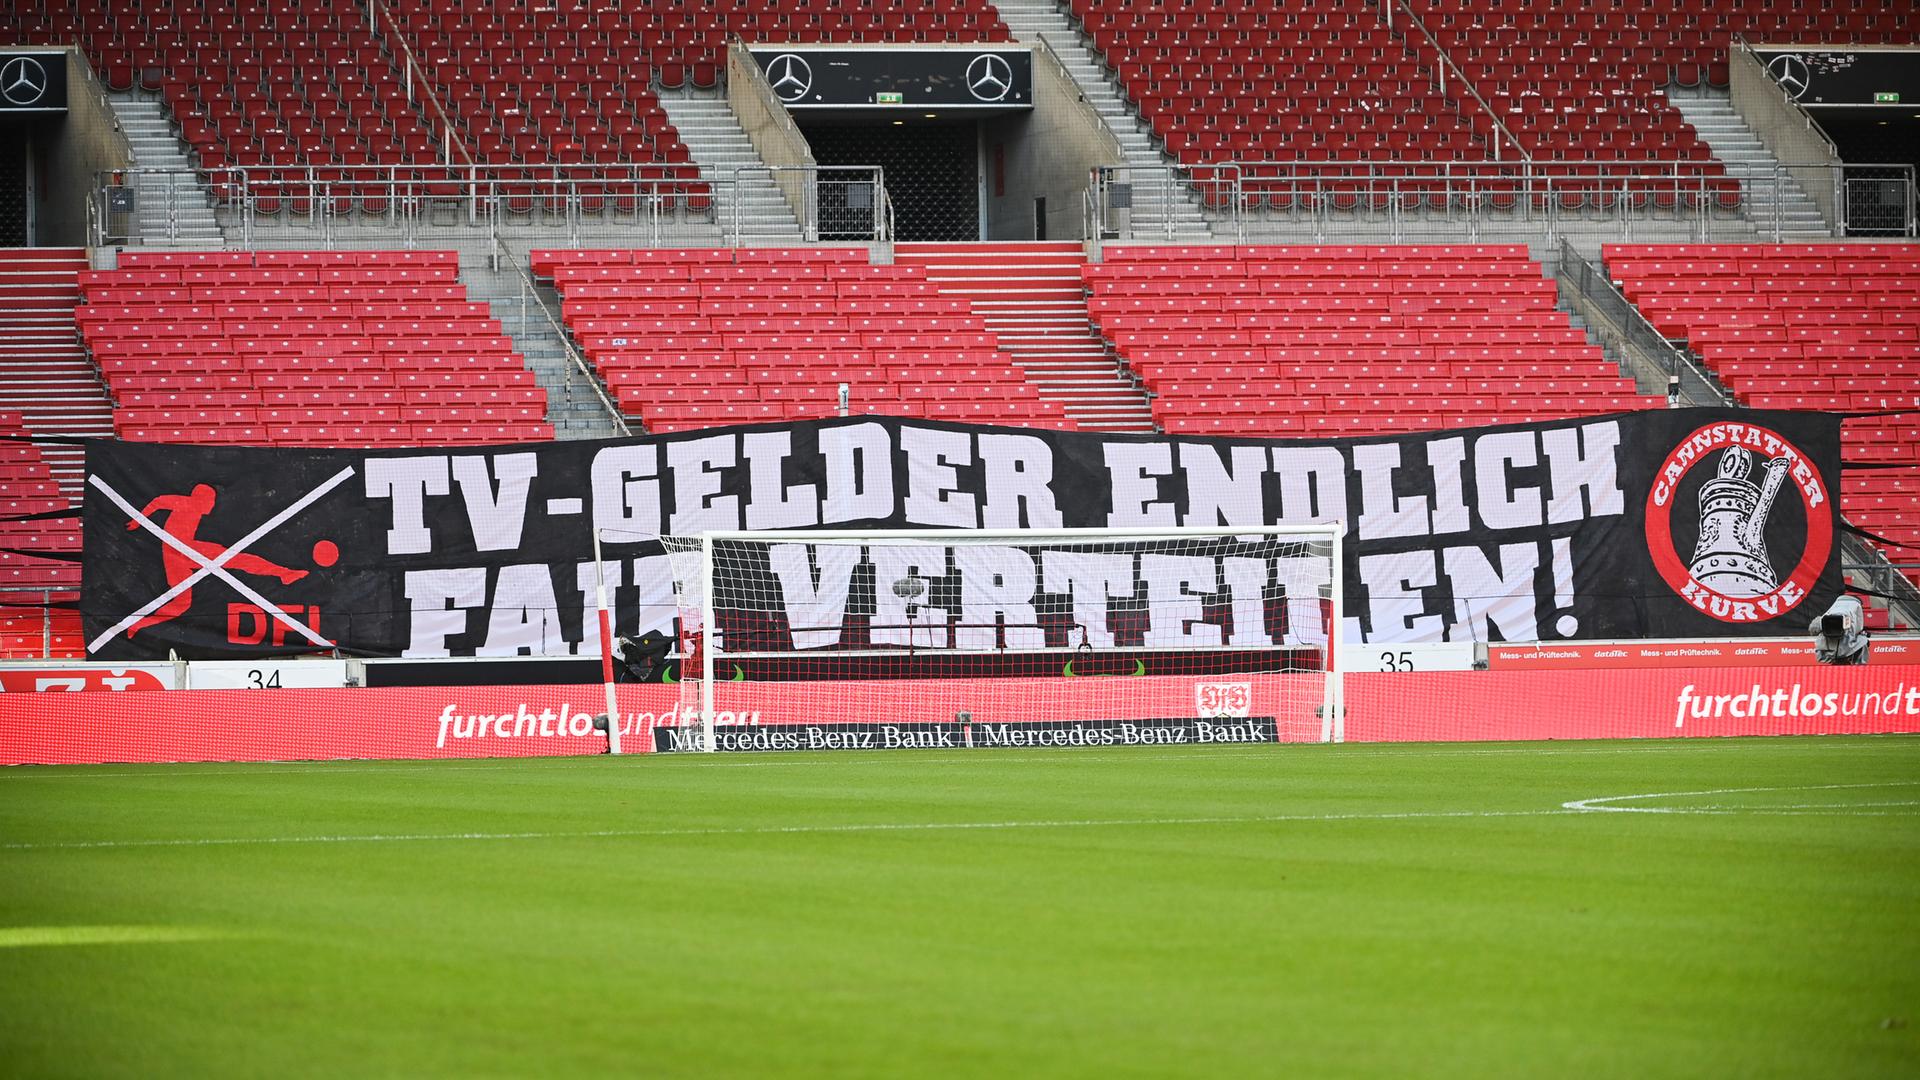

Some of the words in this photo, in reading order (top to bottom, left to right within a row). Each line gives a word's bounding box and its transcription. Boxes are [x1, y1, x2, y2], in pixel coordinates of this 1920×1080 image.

[1654, 424, 1824, 508] CANNSTATTER
[364, 422, 1063, 554] TV-GELDER
[1102, 420, 1625, 544] ENDLICH
[768, 536, 1579, 650] VERTEILEN!
[1680, 579, 1805, 620] KURVE
[227, 602, 337, 647] DFL
[1380, 651, 1414, 672] 35
[1500, 651, 1522, 659] Mess-
[1524, 651, 1537, 659] und
[1641, 649, 1663, 657] Mess-
[1665, 649, 1678, 657] und
[247, 669, 282, 690] 34
[667, 726, 876, 751] Mercedes-Benz
[882, 724, 955, 749] Bank
[984, 722, 1187, 746] Mercedes-Benz
[1194, 719, 1268, 743] Bank
